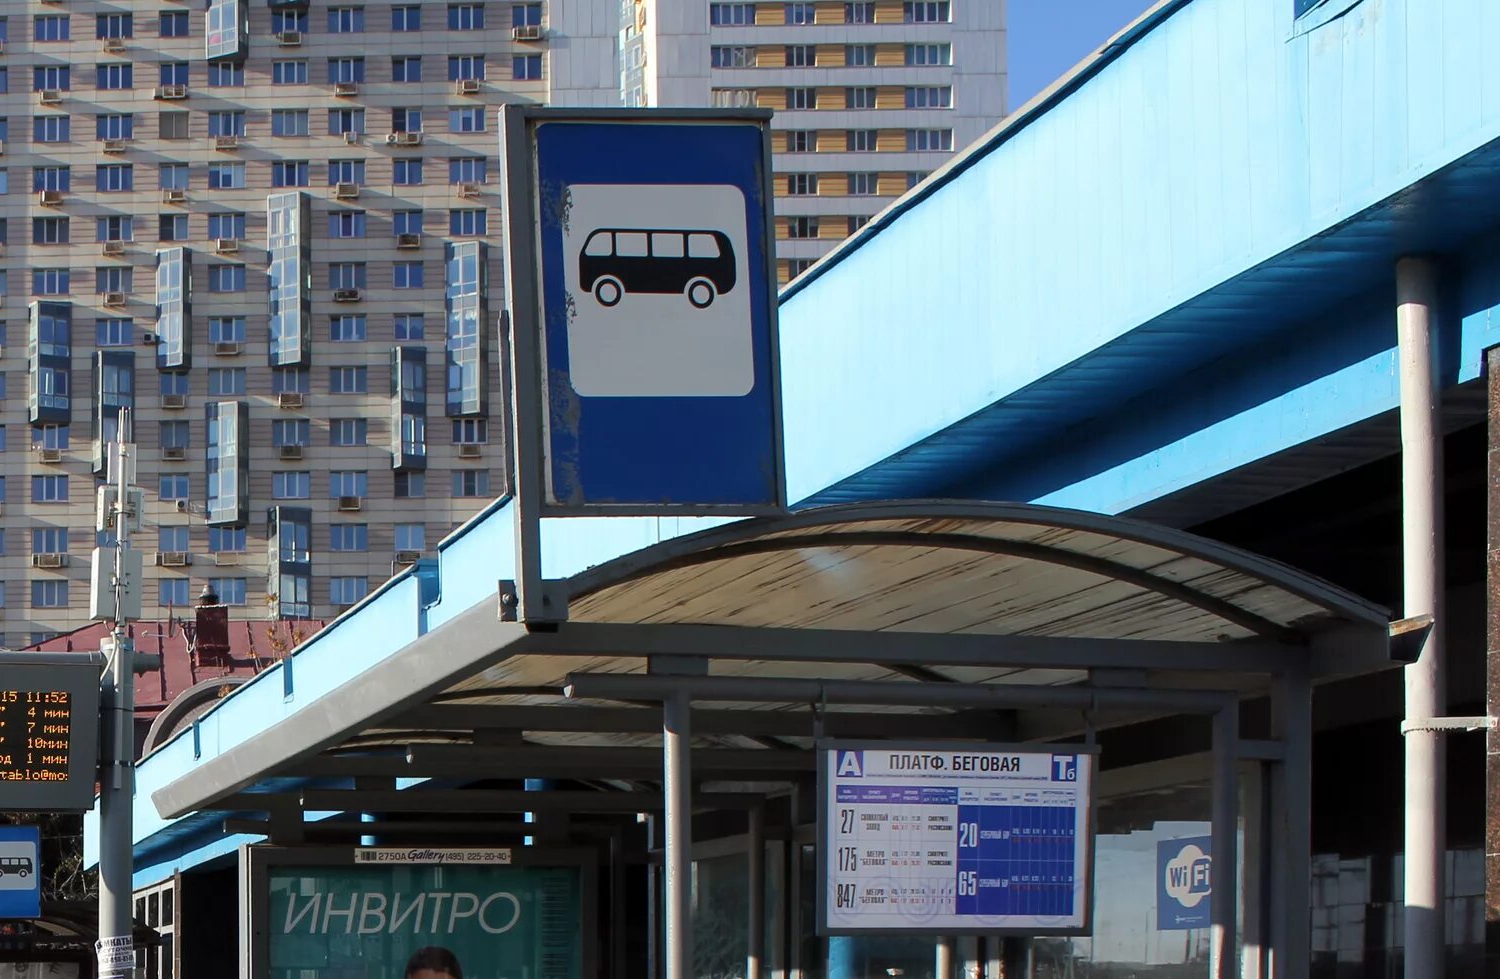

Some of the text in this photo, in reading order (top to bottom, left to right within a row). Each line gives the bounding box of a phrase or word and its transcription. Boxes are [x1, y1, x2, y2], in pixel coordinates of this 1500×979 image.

[26, 690, 68, 702] 11:52
[27, 706, 36, 718] 4
[44, 708, 70, 718] мин
[26, 722, 36, 734] 7
[44, 724, 69, 734] мин
[26, 752, 34, 764] 1
[42, 754, 68, 765] мин
[838, 752, 862, 776] А
[889, 754, 948, 772] ПЛАТФ.
[952, 756, 1020, 772] БЕГОВАЯ
[841, 809, 854, 834] 27
[959, 822, 978, 848] 20
[378, 850, 506, 862] 2750A Gallery (495) 225-20-40
[839, 847, 857, 872] 175
[958, 871, 977, 896] 65
[837, 884, 856, 908] 847
[284, 892, 521, 934] ИНВИТРО
